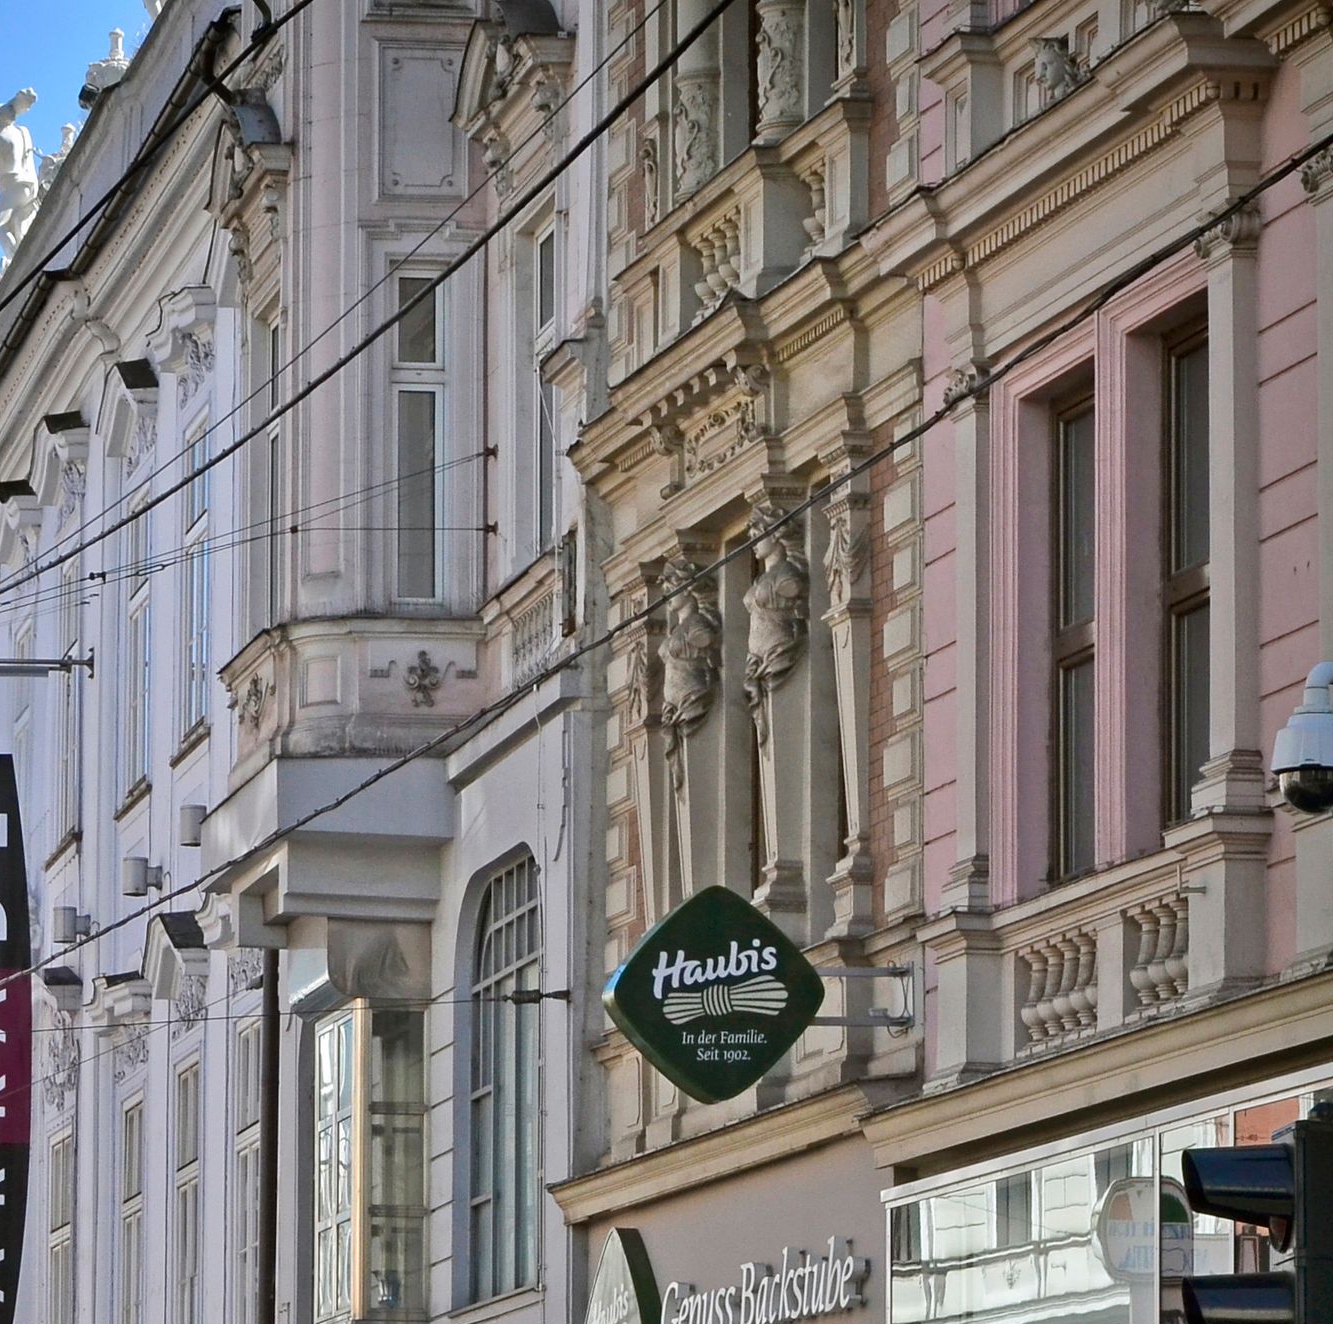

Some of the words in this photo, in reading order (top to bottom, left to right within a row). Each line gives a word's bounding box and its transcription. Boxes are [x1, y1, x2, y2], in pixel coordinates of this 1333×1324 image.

[682, 1031, 694, 1045] In
[697, 1030, 717, 1045] der
[719, 1030, 768, 1045] Familie.
[696, 1048, 720, 1062] Seit
[723, 1050, 752, 1063] 1902.
